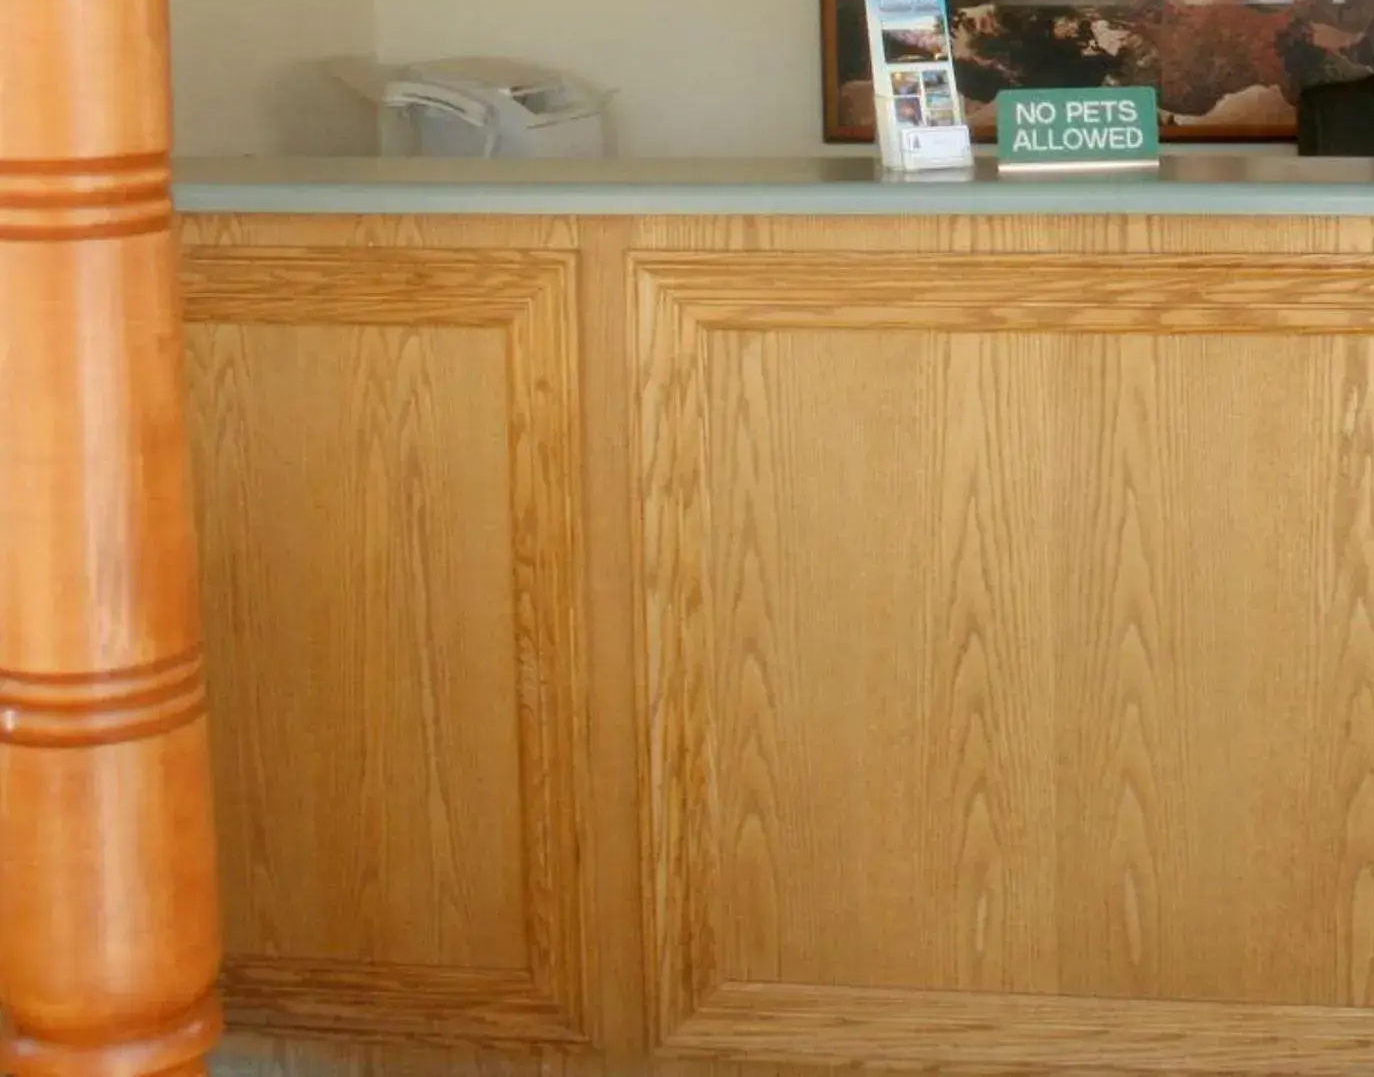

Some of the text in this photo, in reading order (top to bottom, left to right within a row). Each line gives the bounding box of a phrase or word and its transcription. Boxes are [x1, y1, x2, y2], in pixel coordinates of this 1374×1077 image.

[1015, 99, 1138, 125] NO PETS
[1012, 126, 1143, 152] ALLOWED
